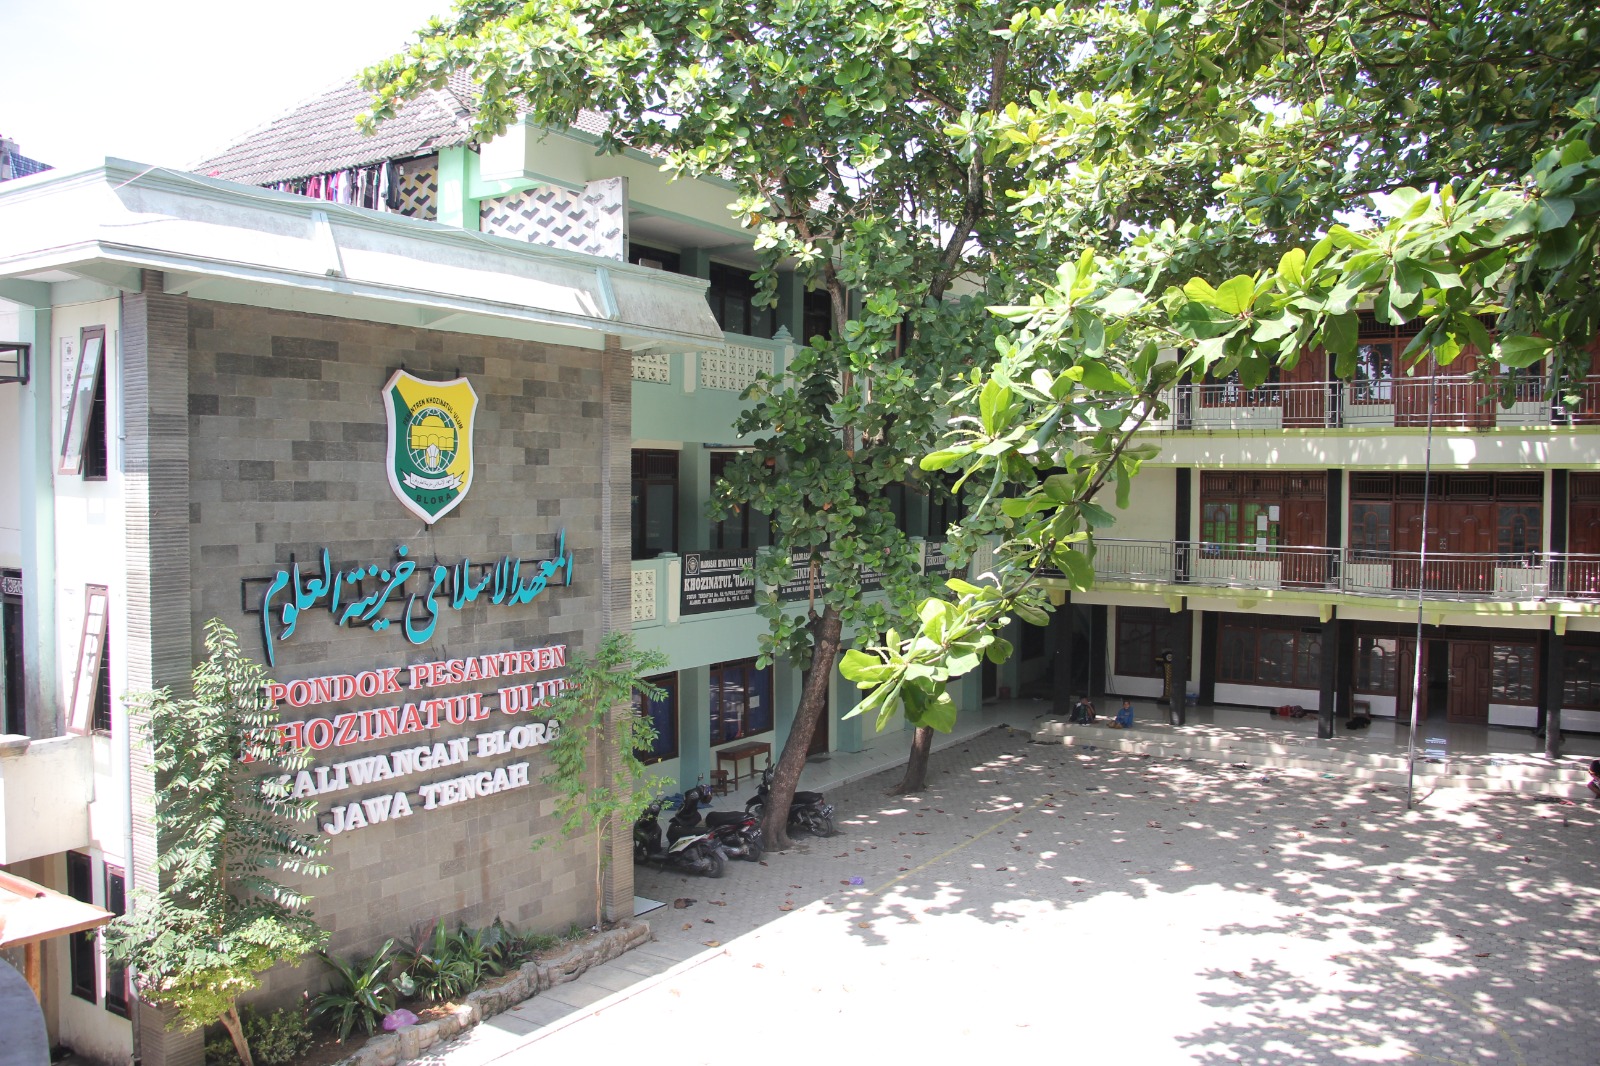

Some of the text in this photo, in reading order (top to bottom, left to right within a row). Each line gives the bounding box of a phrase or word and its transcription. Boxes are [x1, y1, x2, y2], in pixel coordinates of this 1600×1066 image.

[417, 493, 451, 505] BLORA
[684, 575, 732, 592] KHOZINATUL
[264, 645, 566, 711] PONDOK PESANTREN
[499, 679, 582, 715] ULU
[476, 719, 561, 758] BLORA
[323, 762, 529, 835] JAWA TENGAH
